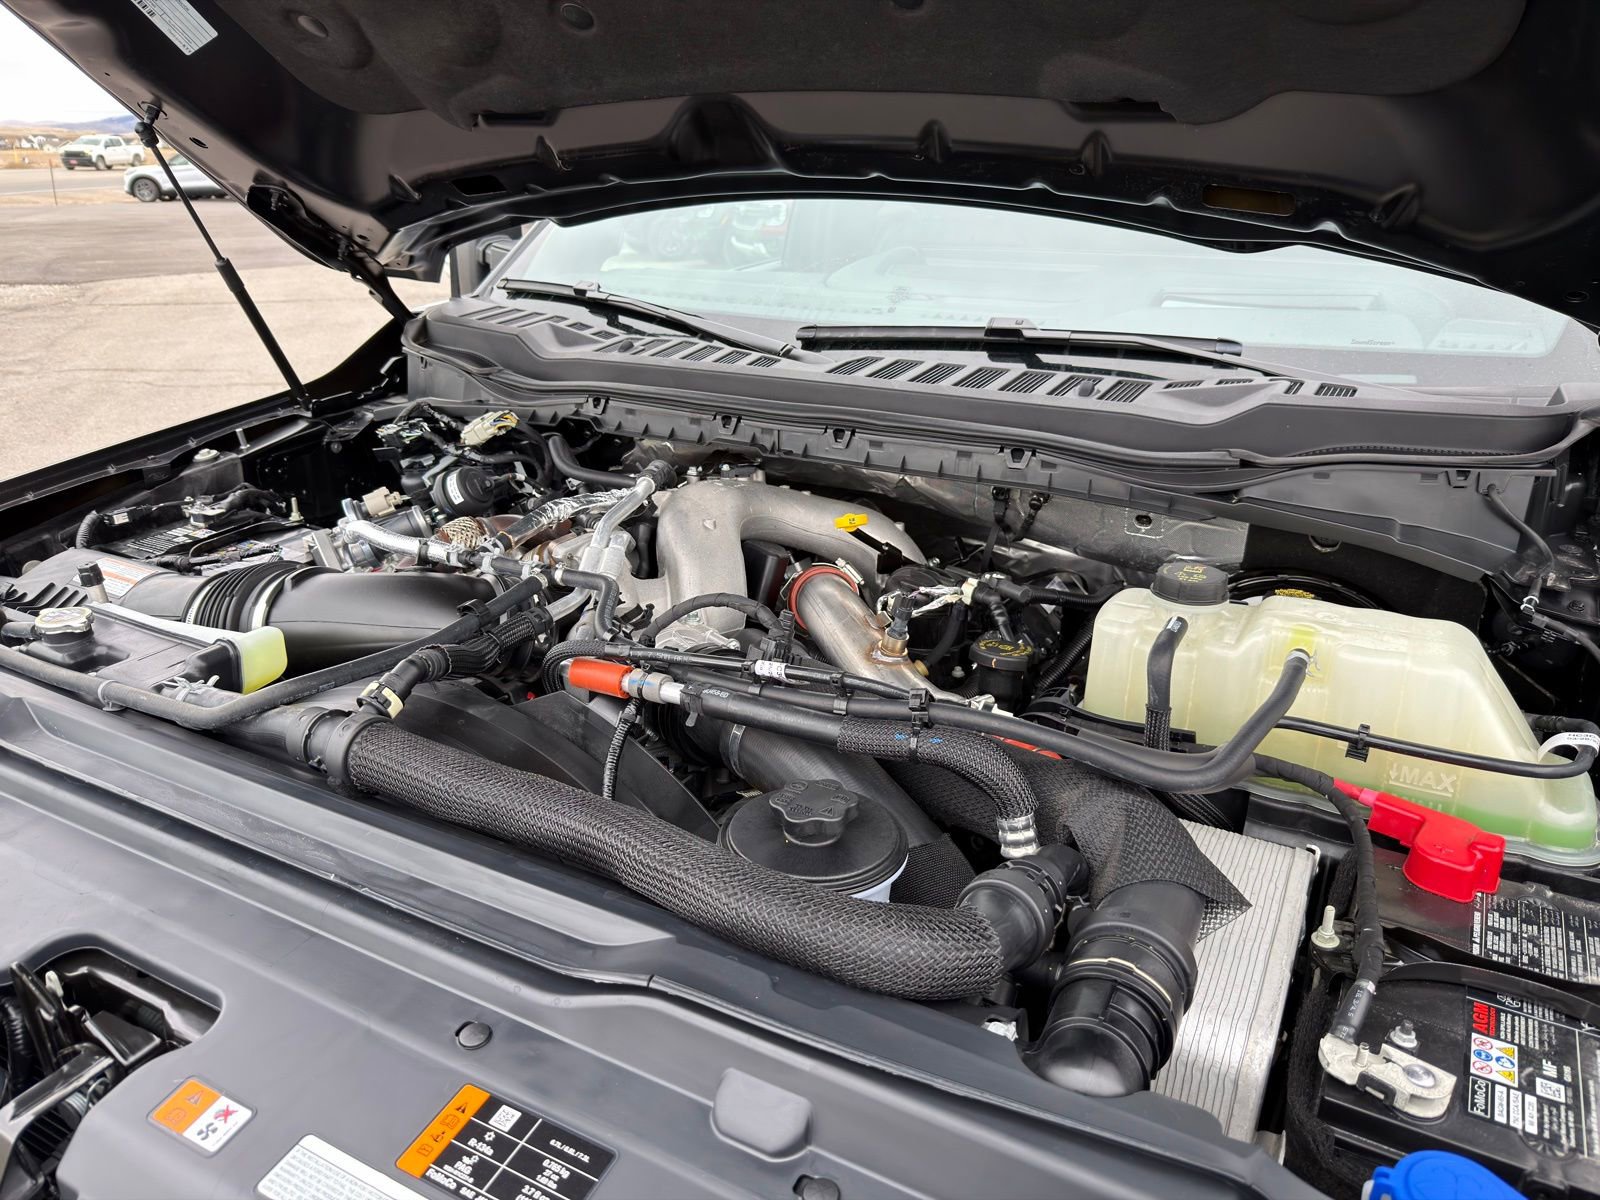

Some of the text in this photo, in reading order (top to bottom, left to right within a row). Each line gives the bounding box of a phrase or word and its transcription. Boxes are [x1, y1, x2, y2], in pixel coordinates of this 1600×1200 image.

[1399, 765, 1457, 793] MAX
[1472, 1000, 1489, 1035] AGM
[1542, 1059, 1558, 1078] MF
[1473, 1079, 1486, 1116] FoMoCo
[425, 1168, 457, 1190] FoMoCo
[454, 1161, 472, 1175] PAG
